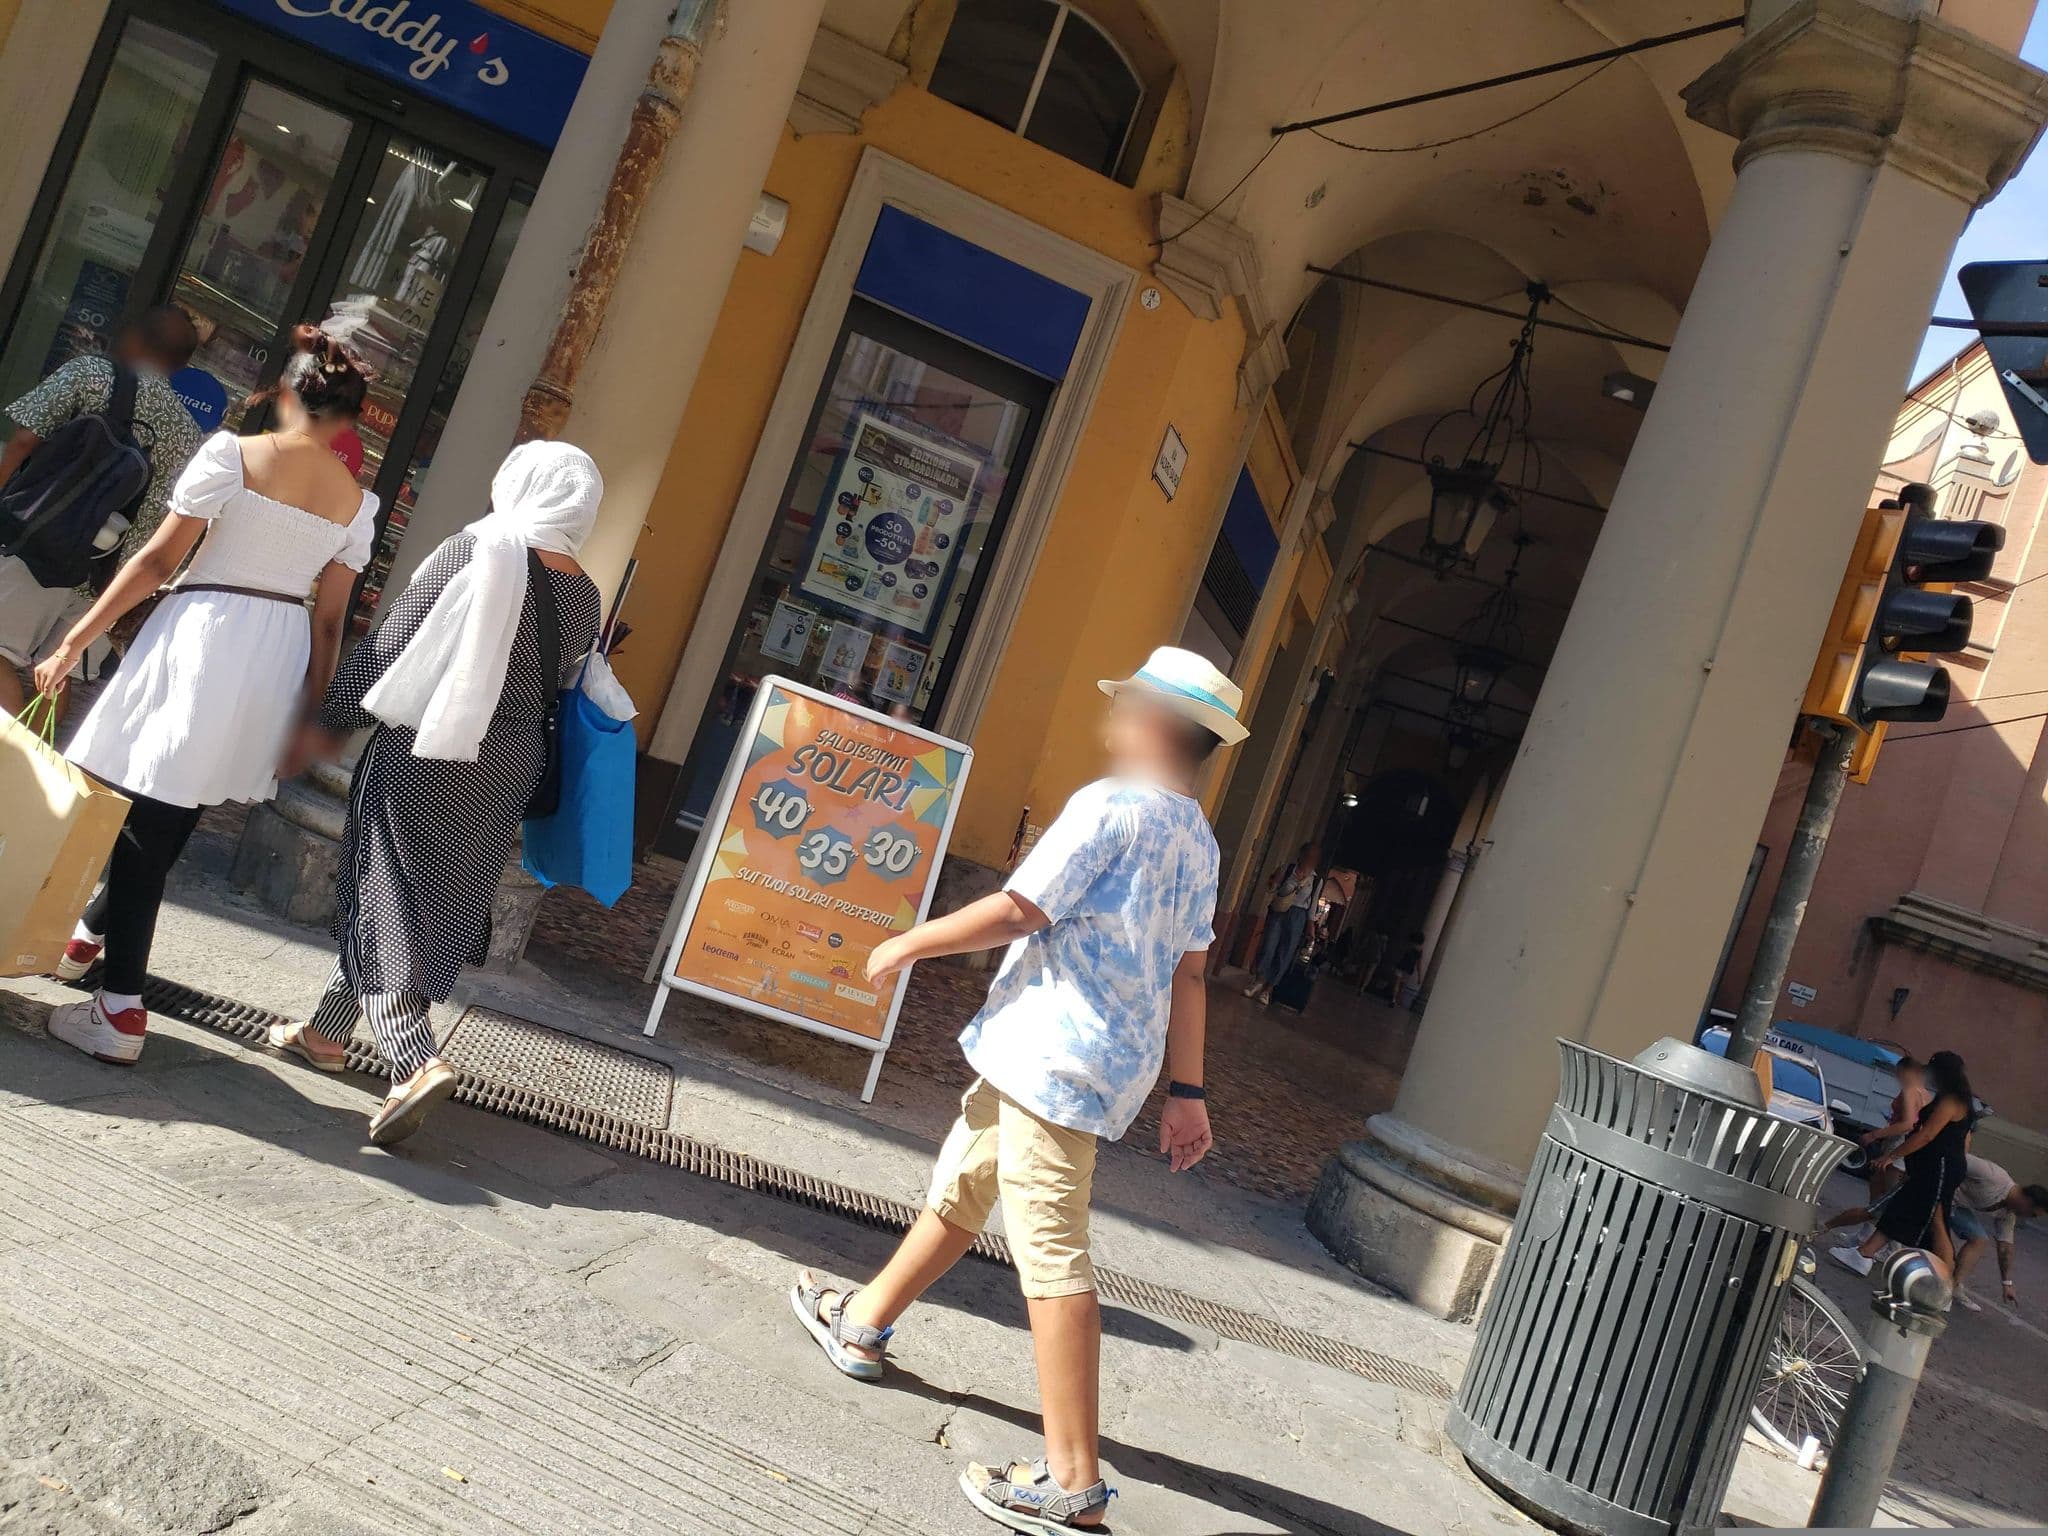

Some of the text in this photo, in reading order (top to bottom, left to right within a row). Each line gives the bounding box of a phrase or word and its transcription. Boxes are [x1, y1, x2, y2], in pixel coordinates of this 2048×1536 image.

[174, 389, 213, 414] ntrata
[886, 520, 902, 533] 50
[816, 729, 910, 772] SALDISSIMI
[786, 744, 921, 813] SOLARI
[735, 866, 895, 929] SUI TUOI SOLARI PREFERITI
